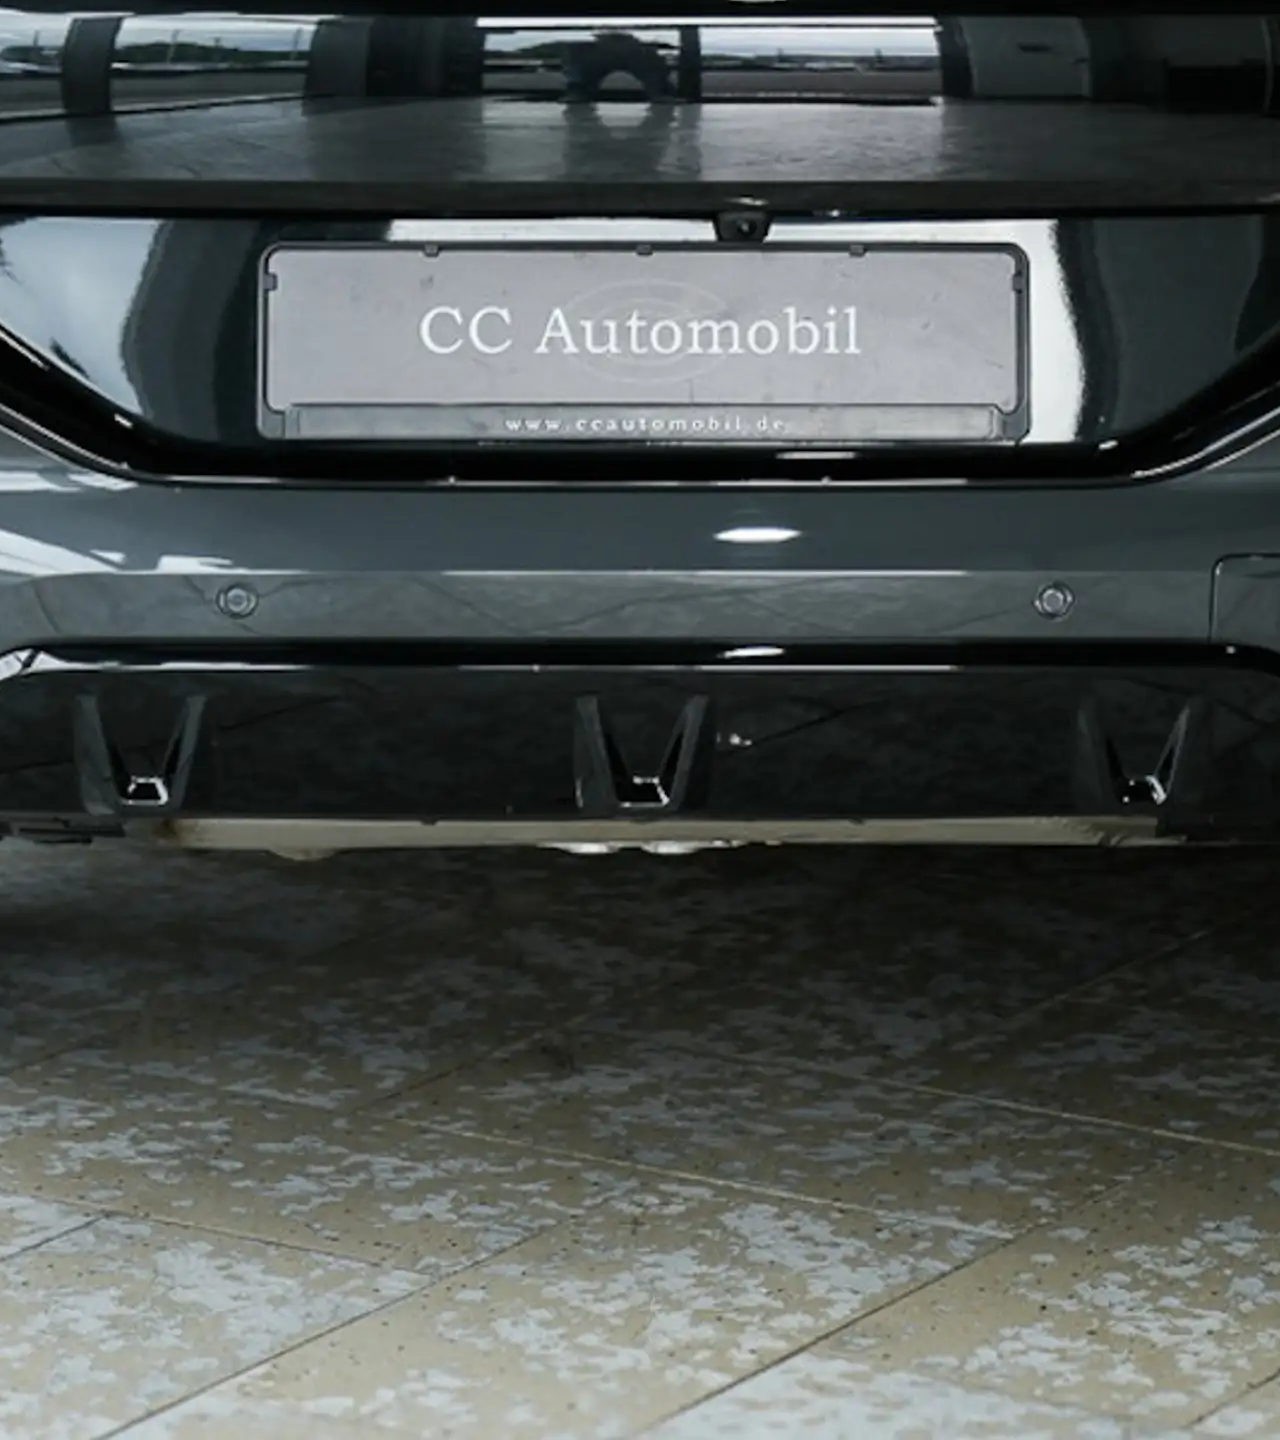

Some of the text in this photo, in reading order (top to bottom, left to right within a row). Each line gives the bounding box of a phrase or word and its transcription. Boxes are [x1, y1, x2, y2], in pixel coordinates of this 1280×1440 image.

[420, 305, 863, 354] CC Automobil
[505, 415, 787, 432] www.ccautomobil.de
